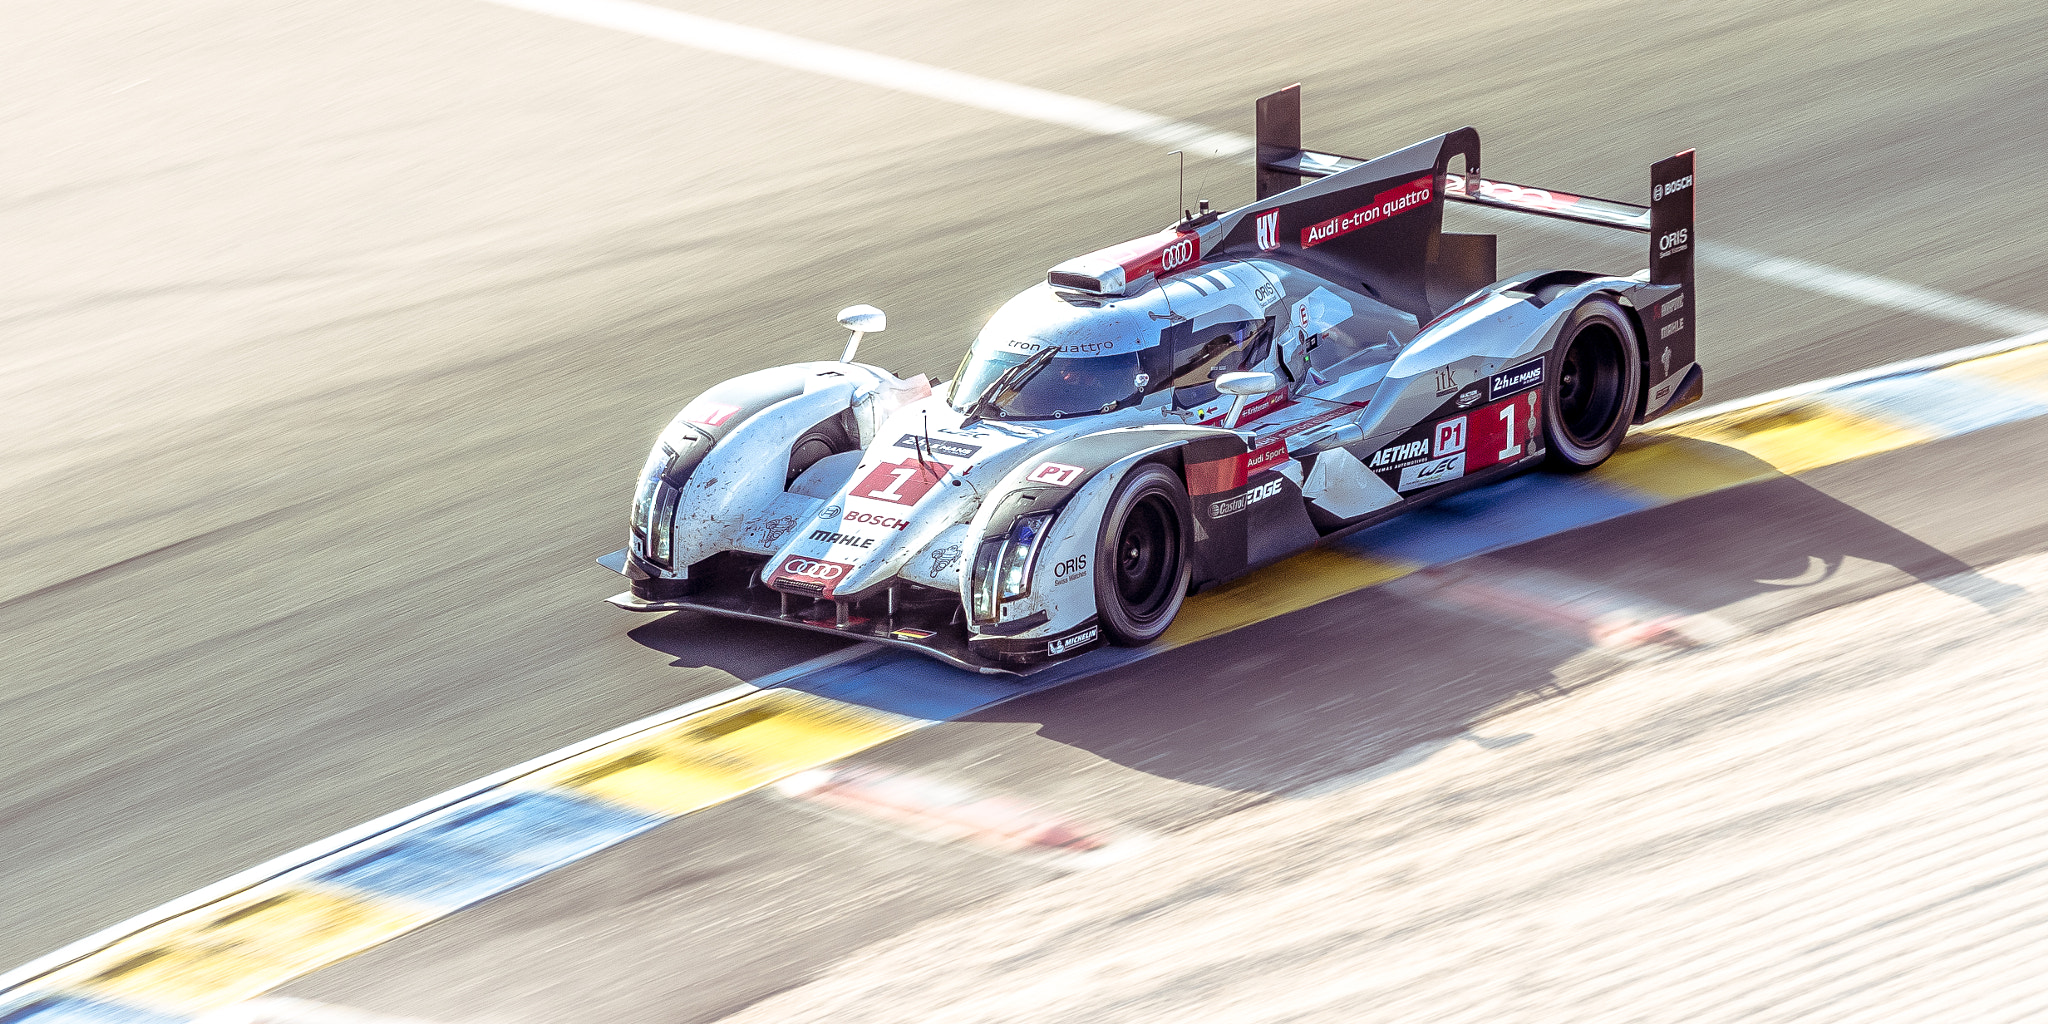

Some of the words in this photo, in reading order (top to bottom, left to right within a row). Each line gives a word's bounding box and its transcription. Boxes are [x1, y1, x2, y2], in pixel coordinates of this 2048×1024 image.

[1664, 175, 1693, 196] BOSCH
[1307, 217, 1339, 243] Audi
[1341, 205, 1380, 230] e-tron
[1382, 188, 1430, 217] quattro
[1256, 211, 1279, 250] HY
[1660, 228, 1688, 250] ORIS
[1255, 282, 1274, 301] ORIS
[1008, 339, 1041, 351] tron
[1435, 364, 1458, 392] itk
[1509, 375, 1521, 386] LE
[1519, 367, 1541, 382] MANS
[1440, 423, 1462, 451] P1
[1498, 403, 1522, 461] 1
[1247, 454, 1264, 468] Audi
[1265, 447, 1285, 461] Sport
[1369, 438, 1429, 468] AETHRA
[867, 467, 918, 501] 1
[1037, 466, 1074, 482] P1
[1219, 496, 1246, 515] Castrol
[1247, 477, 1284, 506] EDGE
[843, 510, 910, 531] BOSCH
[809, 530, 875, 549] MAHLE
[1054, 554, 1087, 578] ORIS
[1064, 629, 1096, 647] MICHELIN
